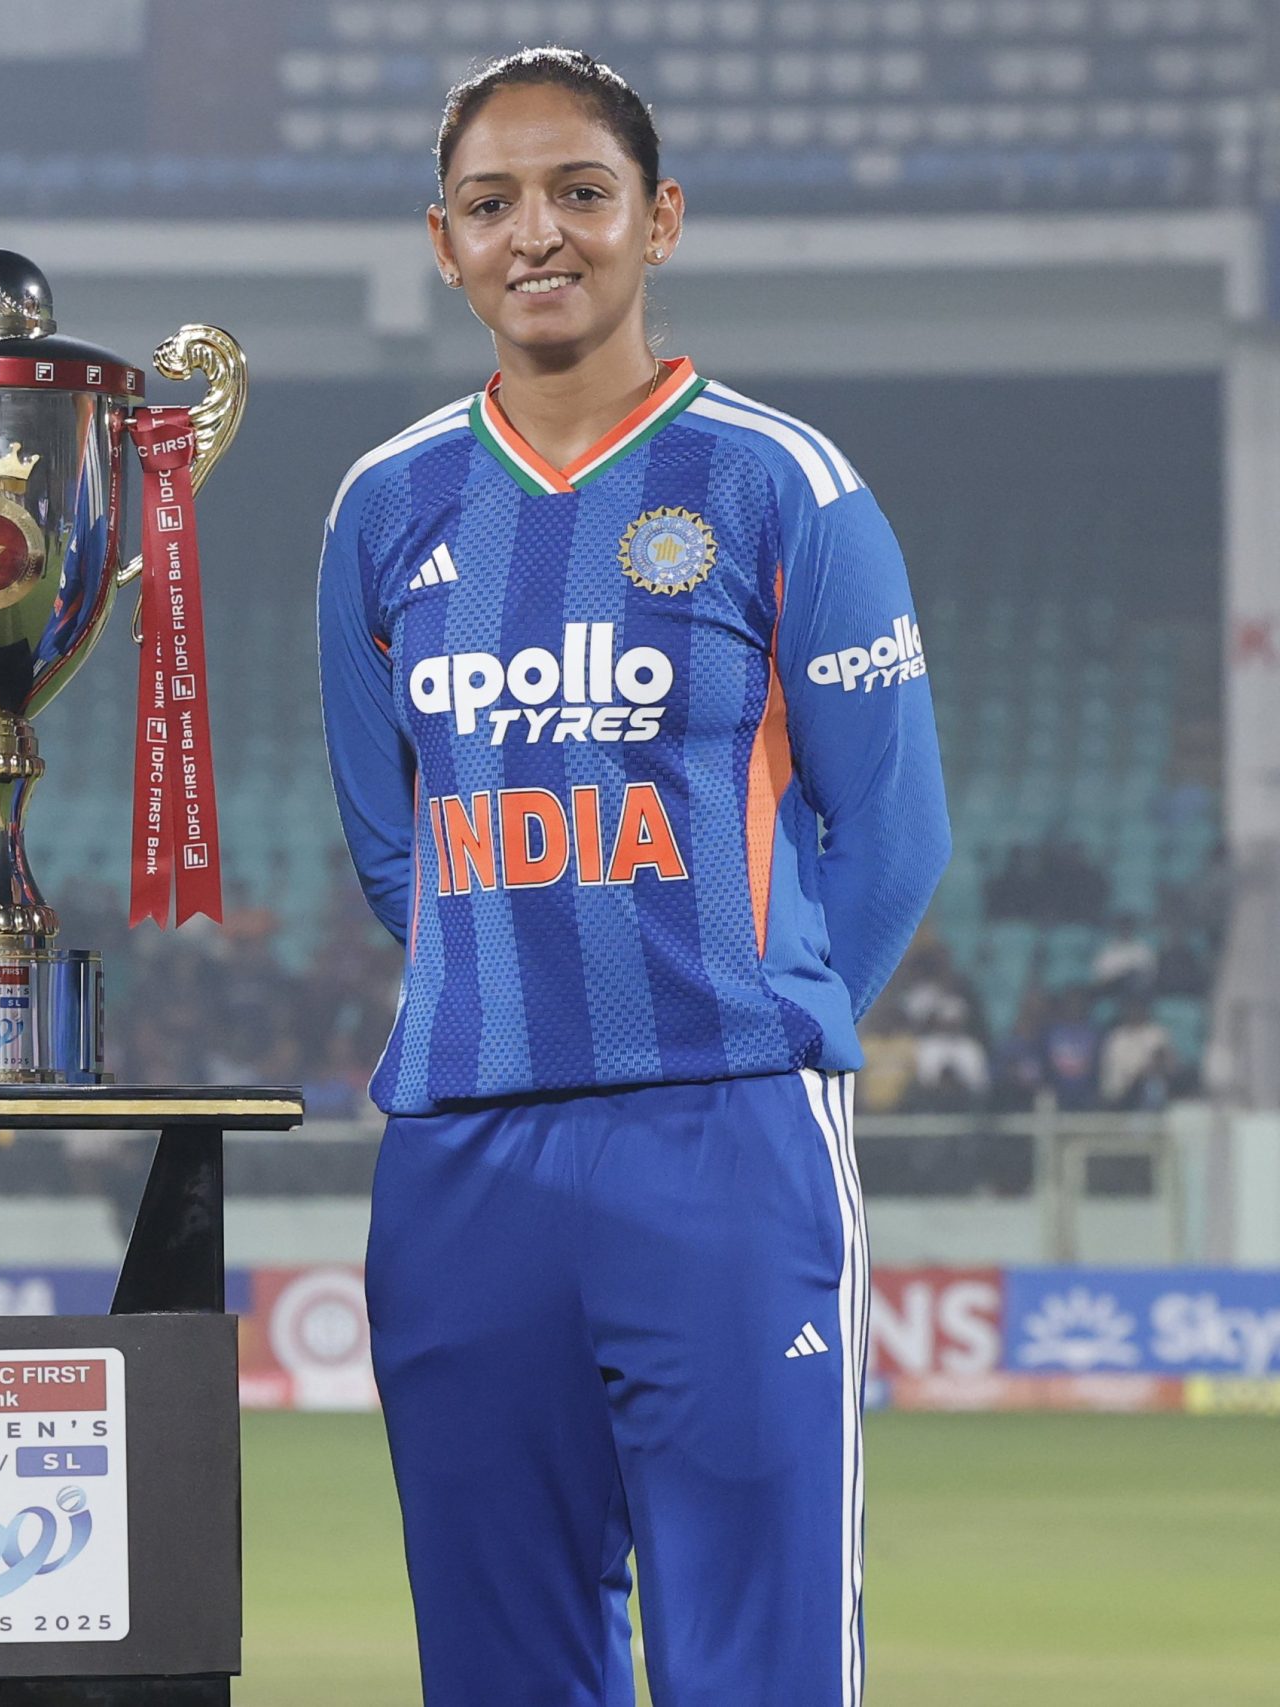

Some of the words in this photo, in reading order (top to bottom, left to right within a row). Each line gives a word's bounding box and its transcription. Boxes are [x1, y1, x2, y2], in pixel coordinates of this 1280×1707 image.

[152, 433, 194, 456] FIRST
[158, 469, 175, 503] IDFC
[166, 541, 182, 581] Bank
[170, 585, 186, 631] FIRST
[174, 634, 189, 671] IDFC
[409, 621, 674, 736] apollo
[179, 710, 194, 750] Bank
[487, 706, 666, 747] TYRES
[150, 746, 165, 783] IDFC
[182, 754, 198, 799] FIRST
[148, 787, 162, 833] FIRST
[186, 803, 201, 840] IDFC
[146, 837, 160, 875] Bank
[429, 781, 689, 897] INDIA
[7, 999, 22, 1007] SL
[23, 1366, 91, 1384] FIRST
[43, 1453, 81, 1470] SL
[34, 1615, 112, 1631] 2025
